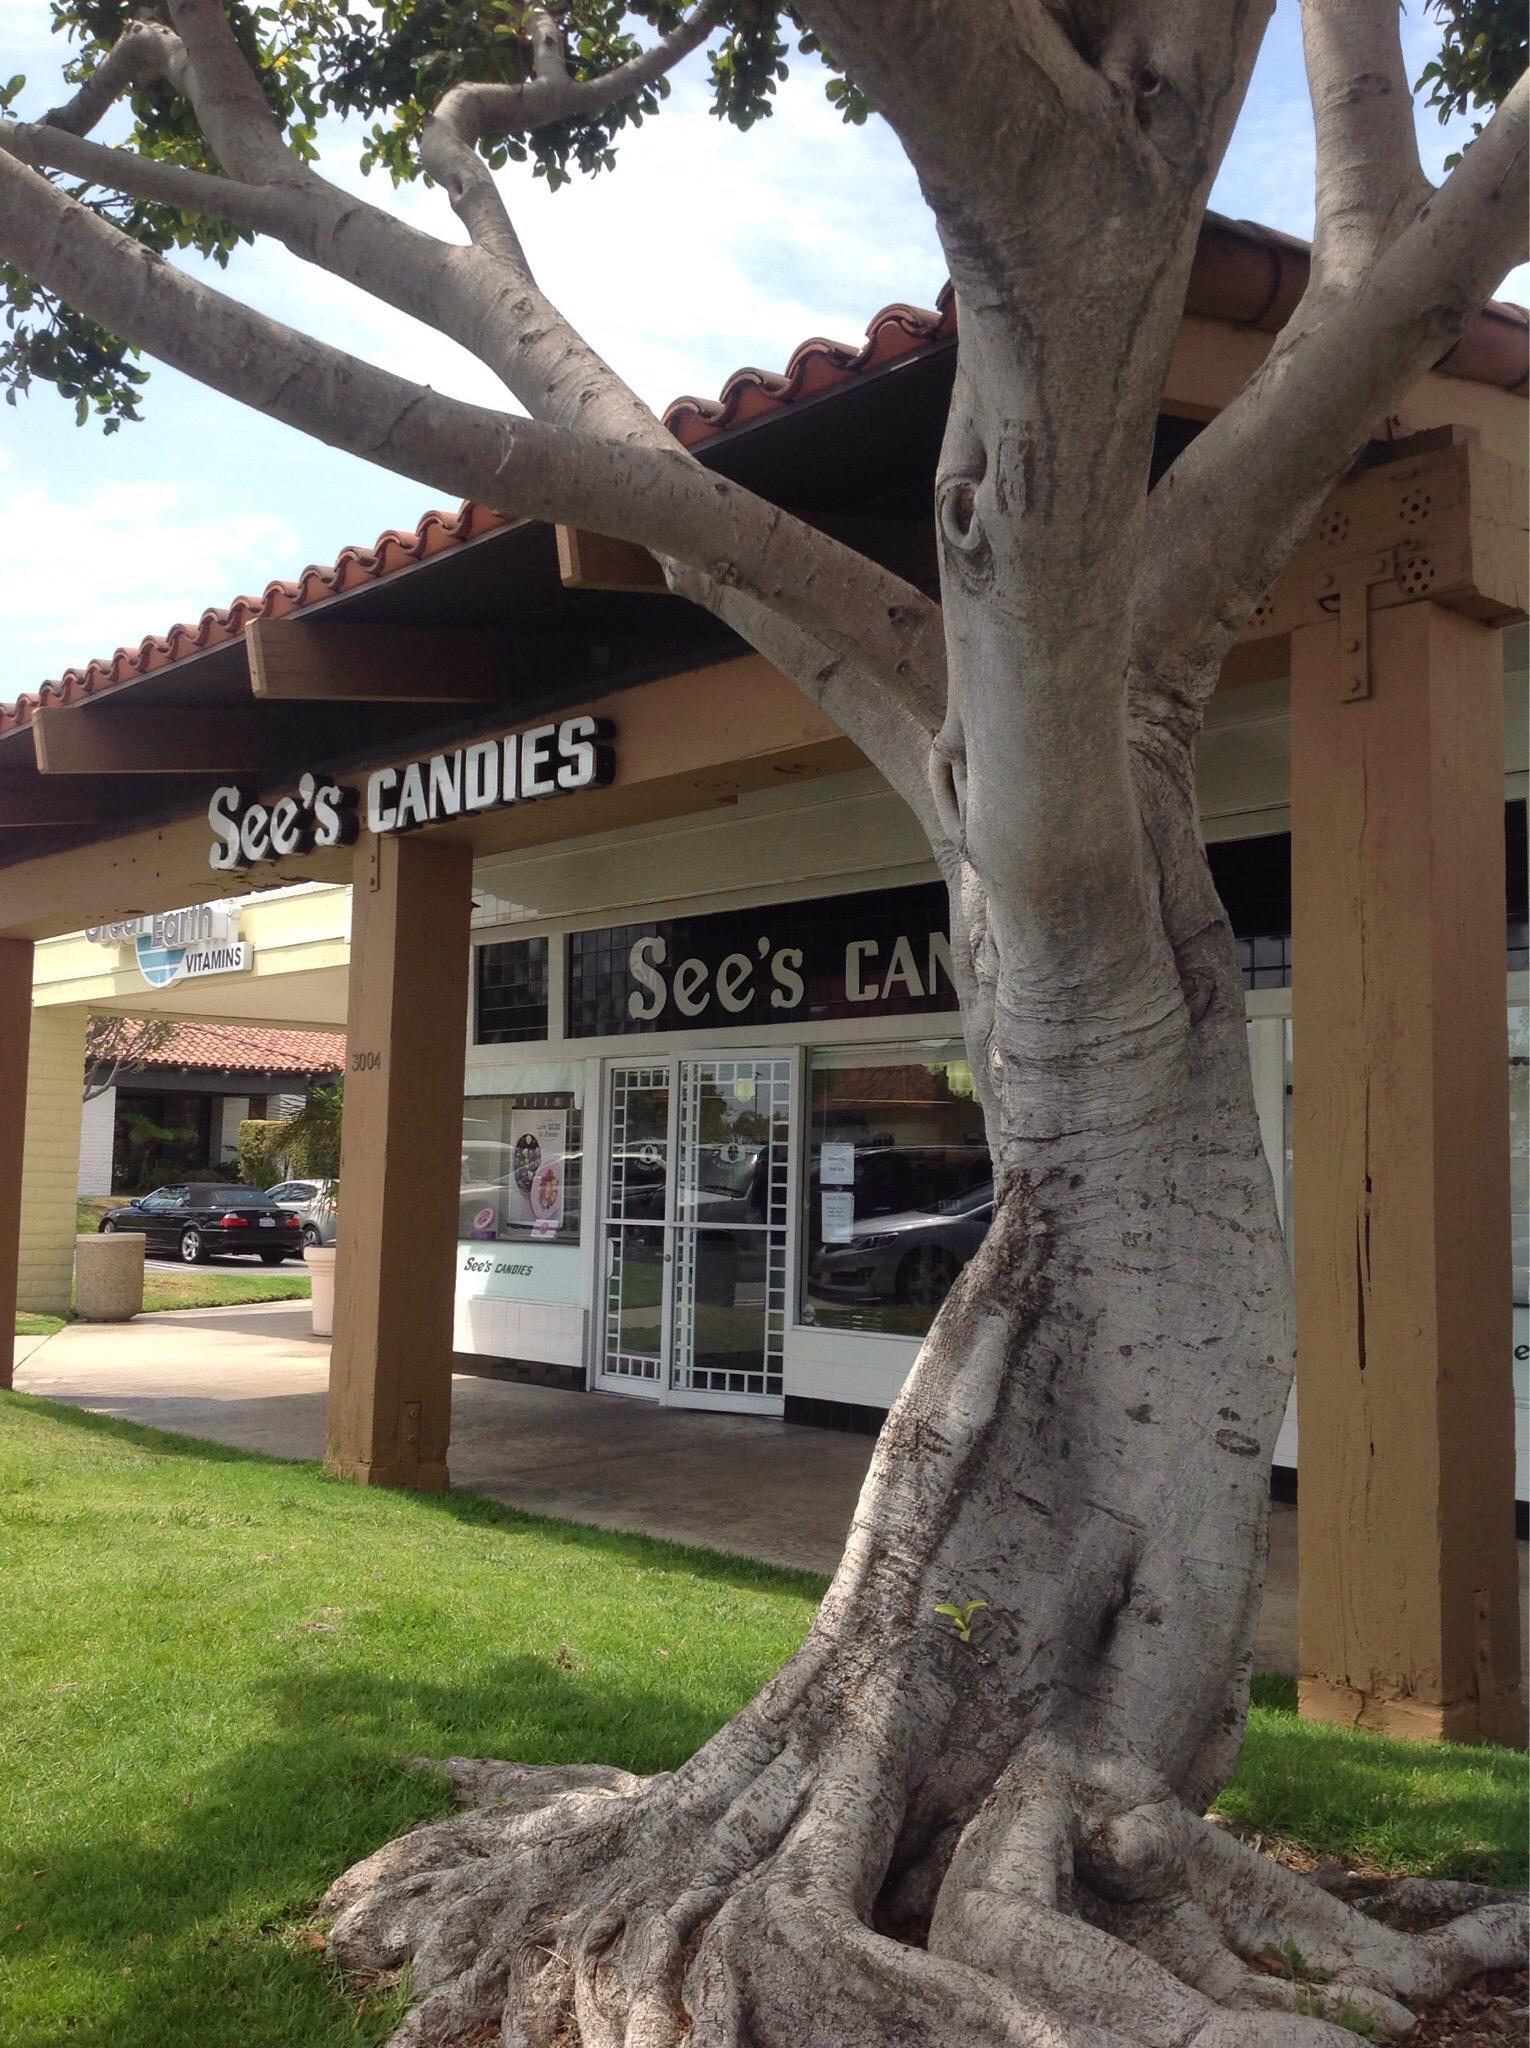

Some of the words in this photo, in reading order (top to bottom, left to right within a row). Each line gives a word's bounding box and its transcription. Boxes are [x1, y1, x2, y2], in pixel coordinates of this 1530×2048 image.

[208, 773, 344, 869] See's
[368, 716, 599, 833] CANDIES
[186, 946, 242, 973] VITAMINS
[628, 936, 804, 1020] See's
[351, 1051, 381, 1072] 3004
[463, 1256, 493, 1273] See's
[494, 1263, 534, 1276] CANDIES
